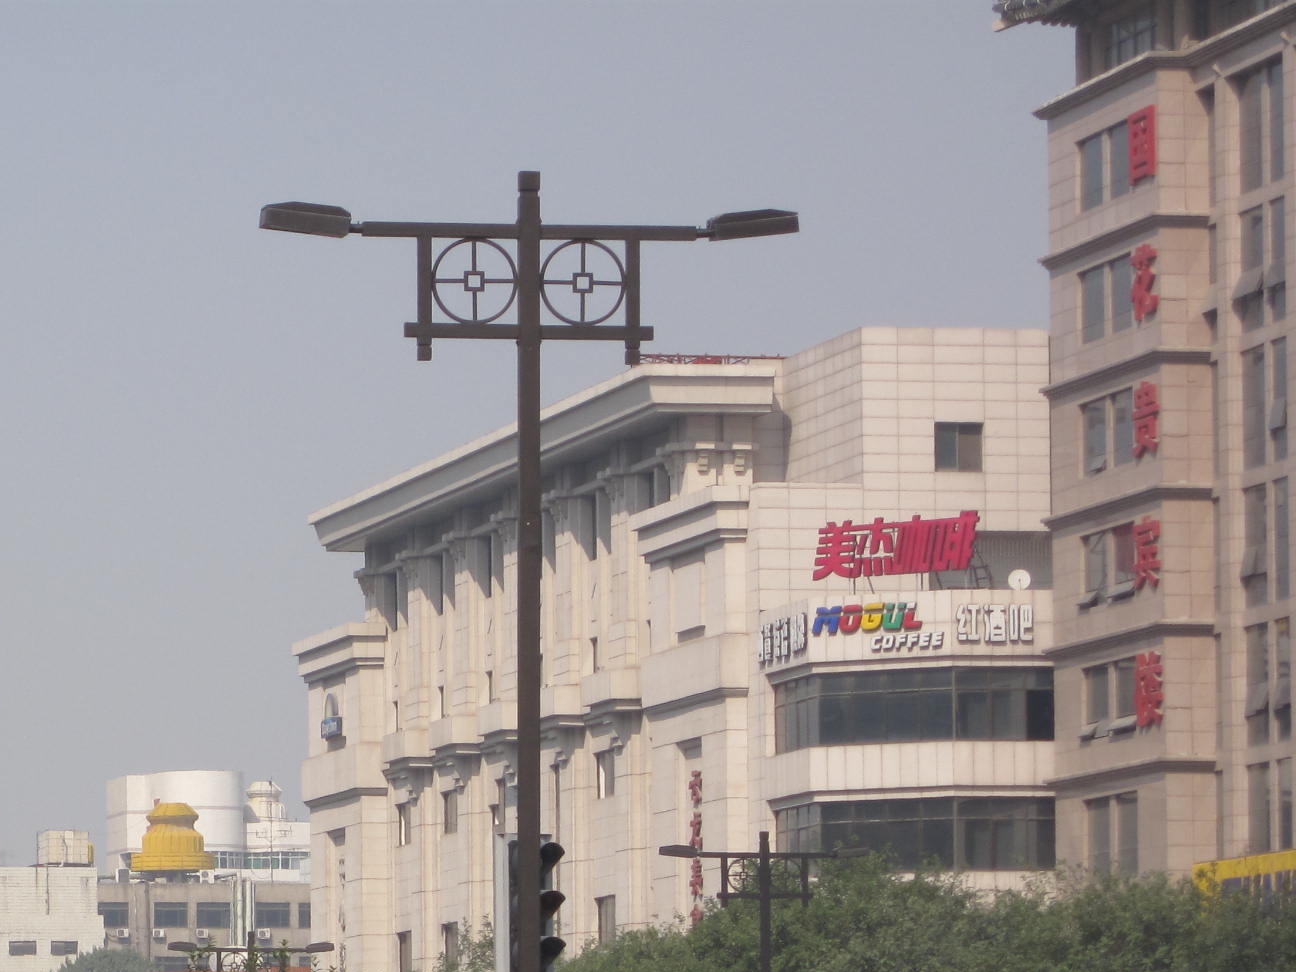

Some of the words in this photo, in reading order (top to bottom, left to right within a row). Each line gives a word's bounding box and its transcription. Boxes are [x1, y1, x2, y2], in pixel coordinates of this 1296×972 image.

[812, 602, 923, 635] MOGUL
[956, 604, 1034, 643] 红酒吧
[870, 631, 945, 652] COFFEE
